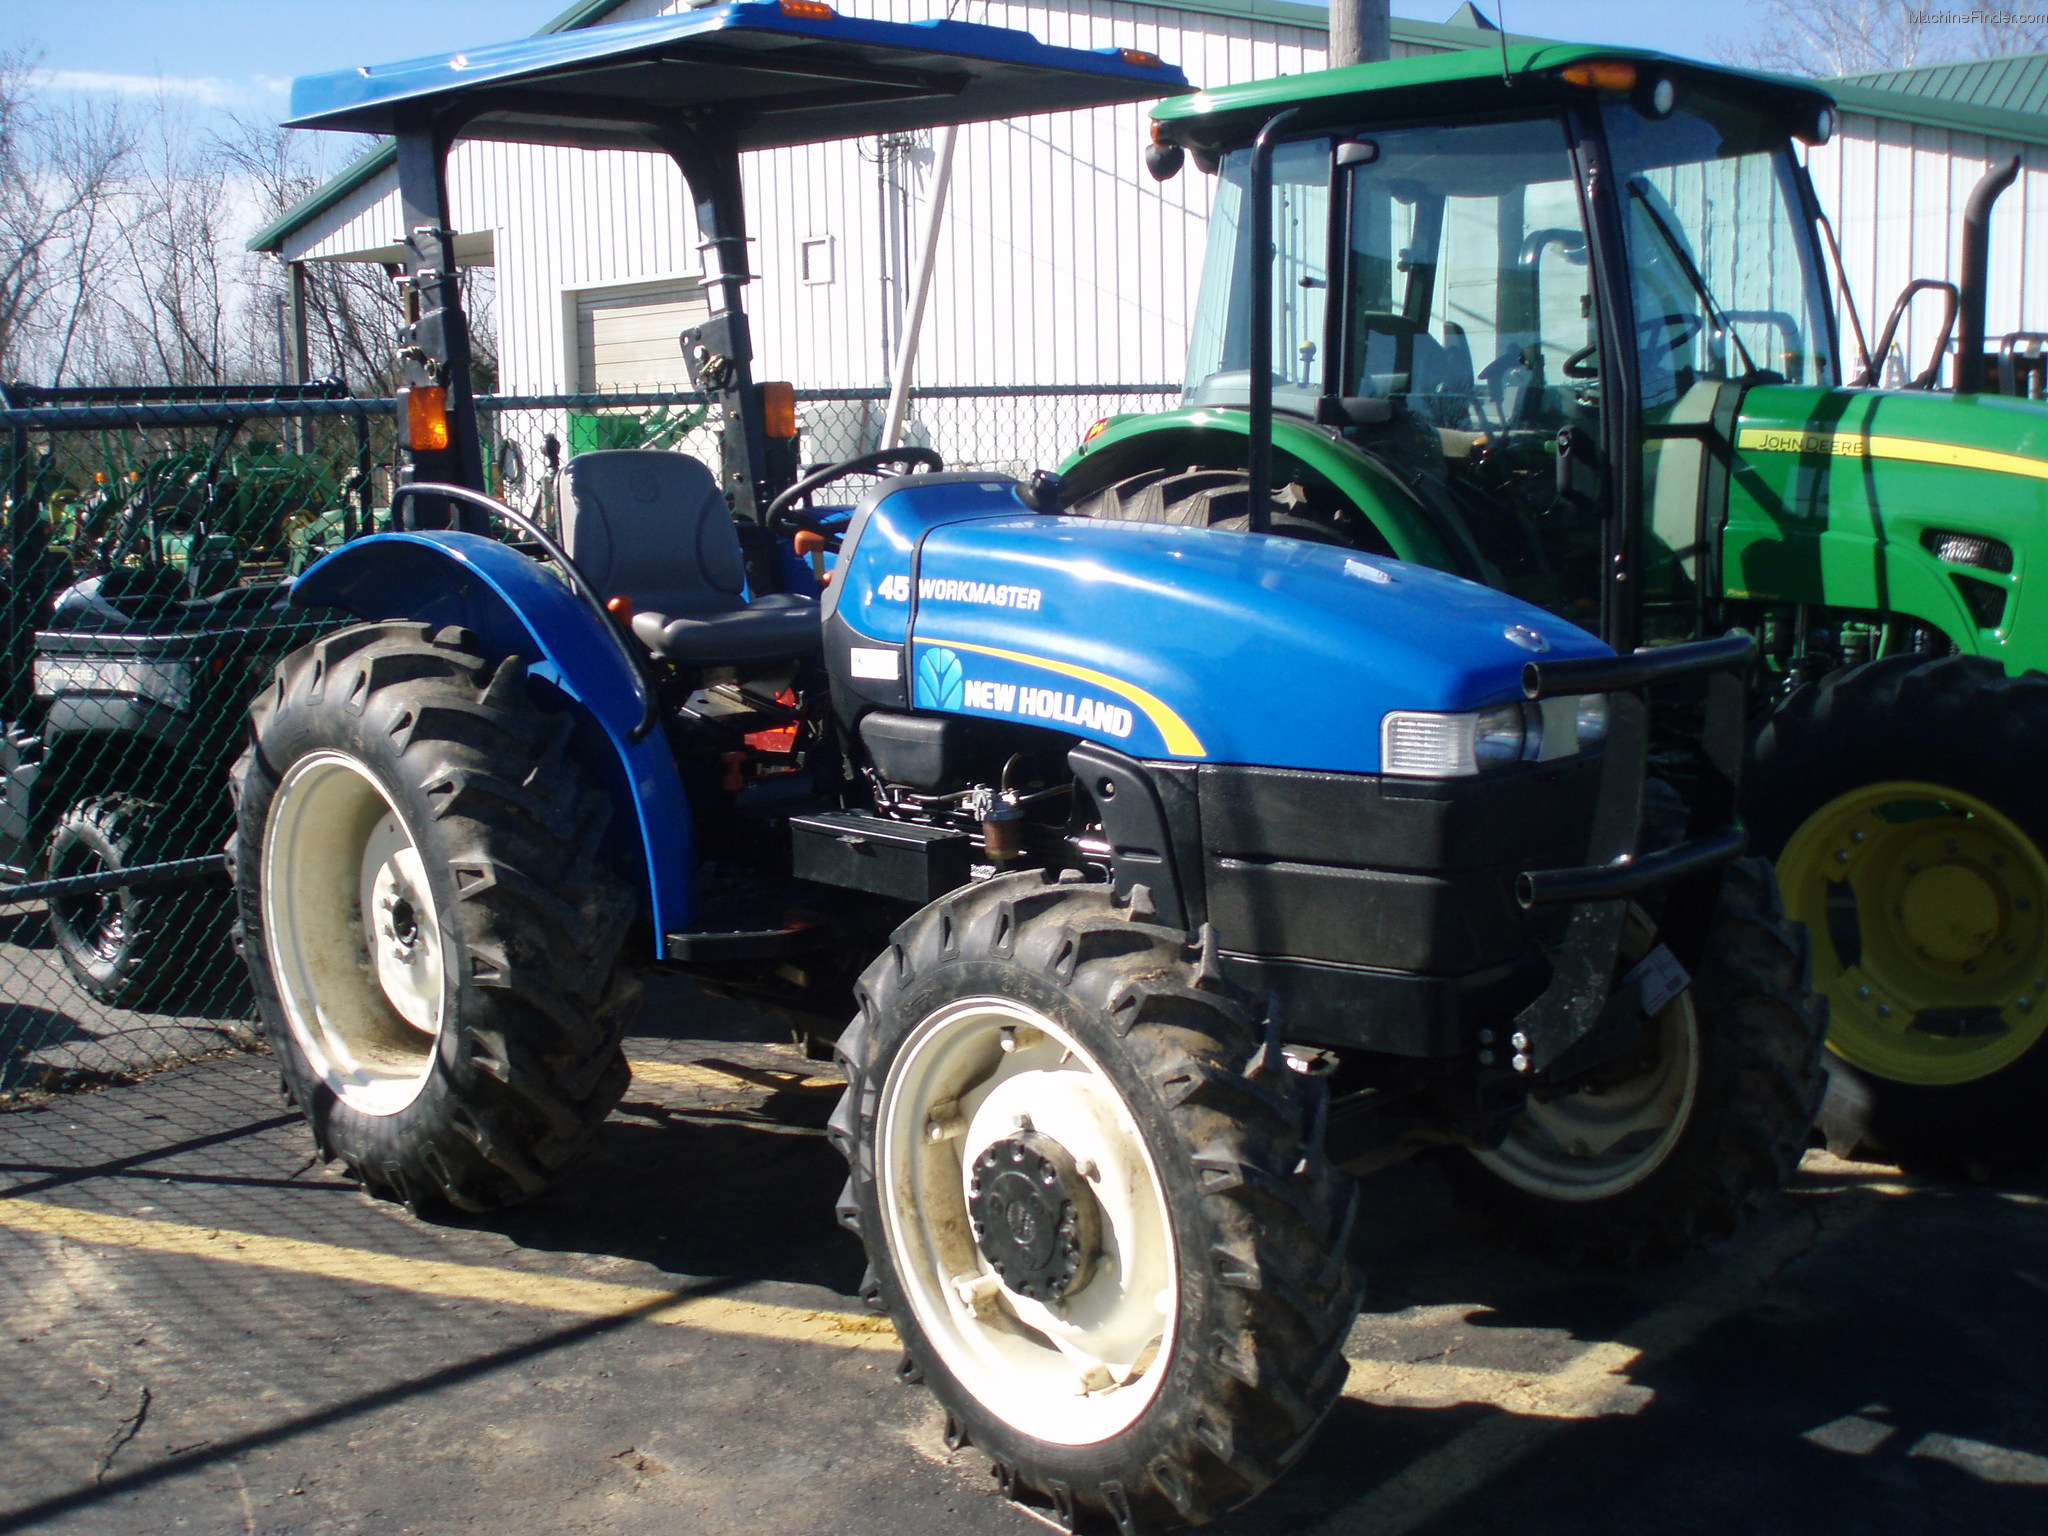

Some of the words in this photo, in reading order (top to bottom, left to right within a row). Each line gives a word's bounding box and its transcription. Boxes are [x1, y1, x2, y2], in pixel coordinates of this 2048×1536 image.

[1759, 434, 1804, 451] JOHN
[1805, 436, 1863, 454] DEERE
[877, 574, 911, 602] 45
[917, 578, 1042, 611] WORKMASTER
[963, 679, 1017, 710] NEW
[1018, 686, 1133, 738] HOLLAND
